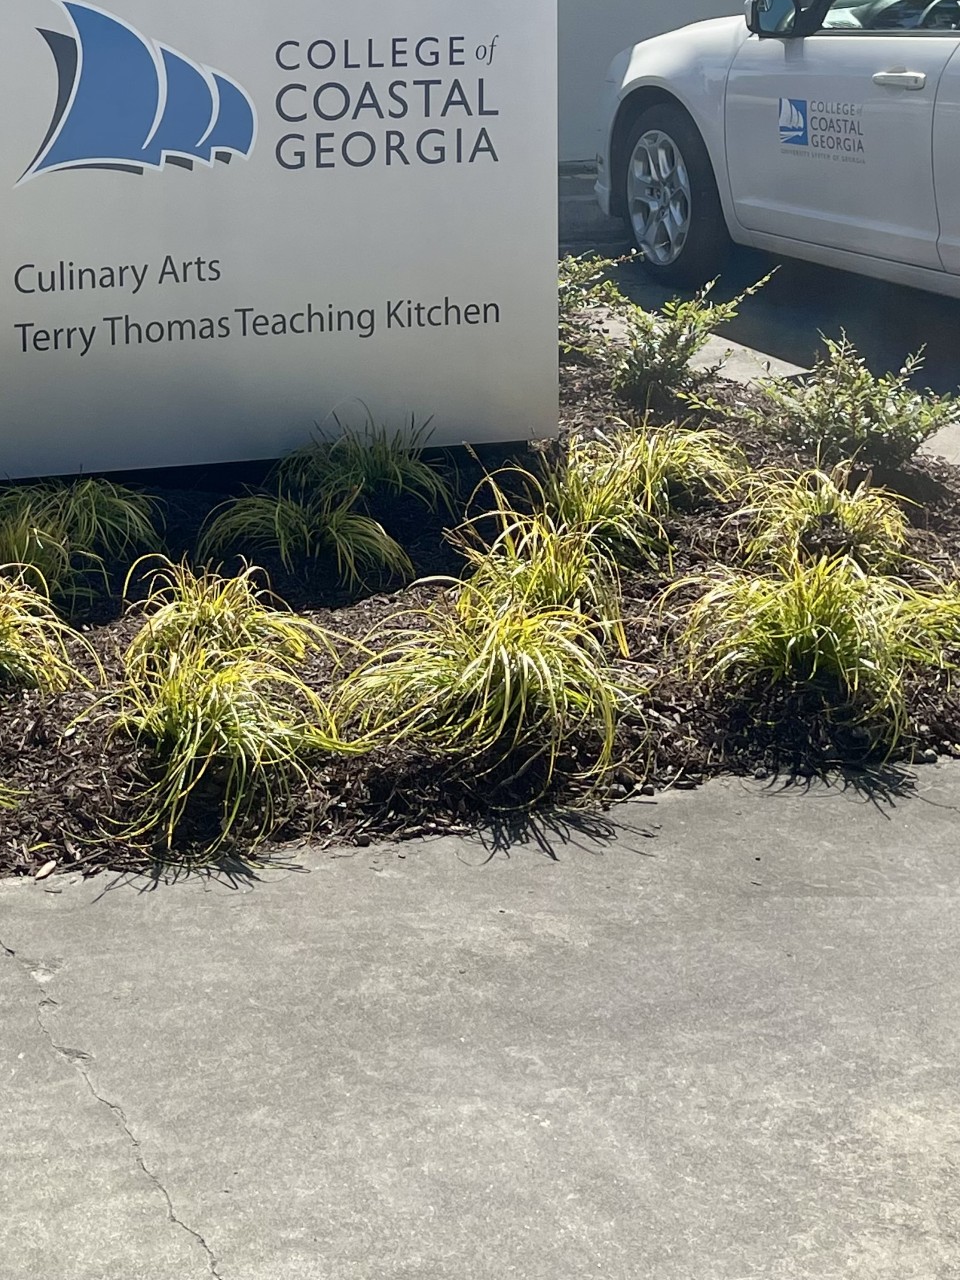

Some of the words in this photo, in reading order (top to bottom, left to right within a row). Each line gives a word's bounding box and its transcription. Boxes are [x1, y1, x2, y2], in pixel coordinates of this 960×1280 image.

[275, 36, 466, 71] COLLEGE
[475, 35, 499, 65] of
[275, 78, 500, 122] COASTAL
[810, 100, 855, 116] COLLEGE
[810, 116, 864, 136] COASTAL
[811, 134, 864, 153] GEORGIA
[275, 128, 500, 170] GEORGIA
[14, 261, 148, 294] Culinary
[158, 254, 222, 285] Arts
[14, 323, 97, 357] Terry
[103, 314, 231, 347] Thomas
[235, 304, 376, 339] Teaching
[386, 296, 501, 329] Kitchen
